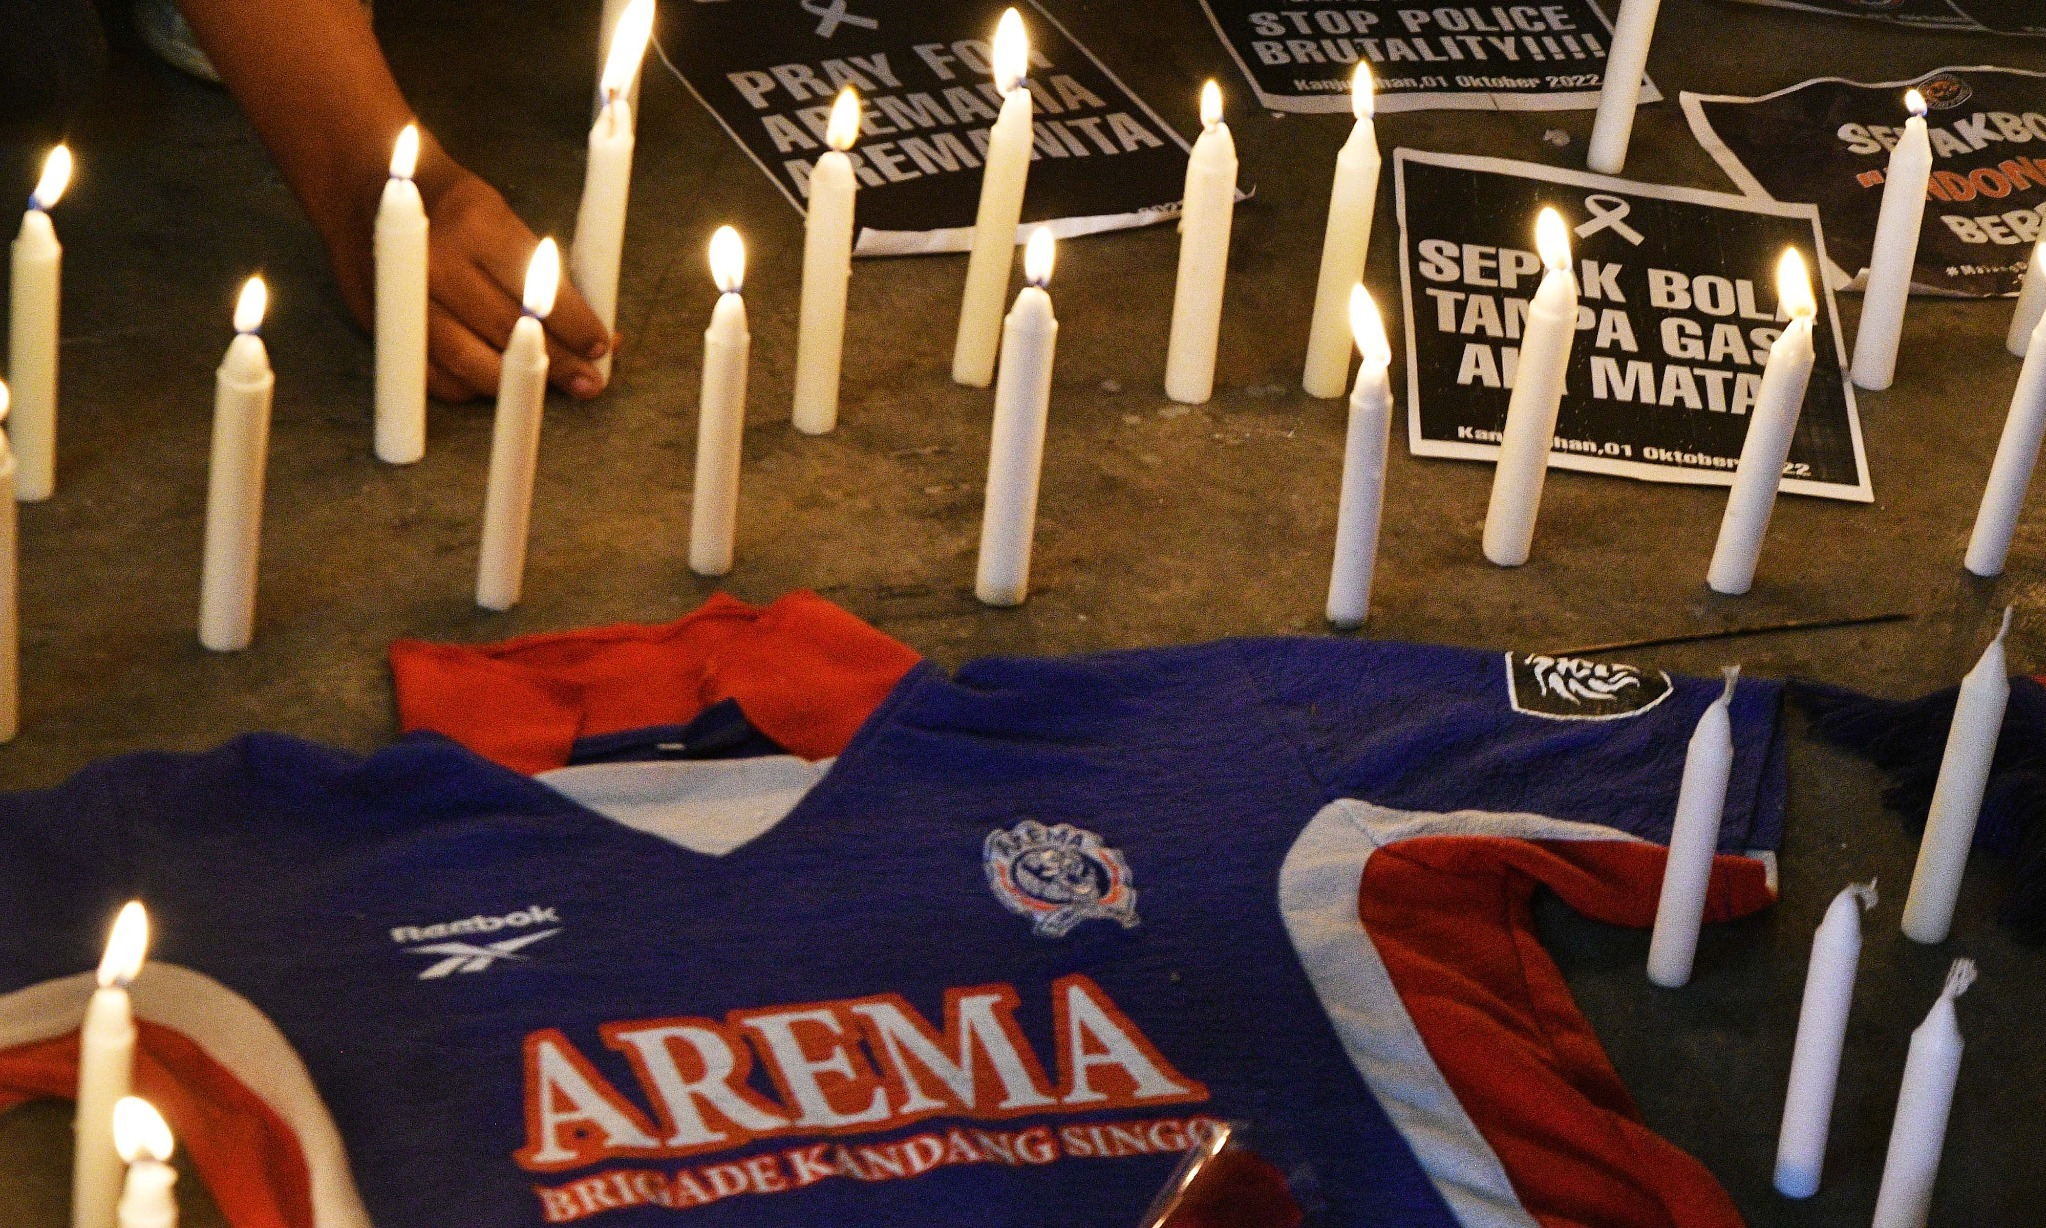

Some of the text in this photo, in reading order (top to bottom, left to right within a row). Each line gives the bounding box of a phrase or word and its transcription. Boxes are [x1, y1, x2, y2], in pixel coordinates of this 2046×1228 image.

[1249, 5, 1577, 36] STOP POLICE
[1251, 32, 1606, 66] BRUTALITY!!!!
[726, 39, 1055, 109] PRAY FO
[1294, 73, 1602, 92] Kanjhan,01 Oktober 2022
[1837, 112, 2046, 157] SEAKBO
[1939, 202, 2046, 245] BER
[1418, 239, 1818, 326] SEPK BOL
[1661, 317, 1783, 367] GAS
[1457, 343, 1764, 415] AI MATA
[1458, 426, 1632, 457] Kanhan,01
[1643, 446, 1740, 470] Oktober
[390, 904, 560, 943] Reebok
[514, 973, 1210, 1171] AREMA
[533, 1114, 1226, 1222] BRIGADE KANDANG SINGO
